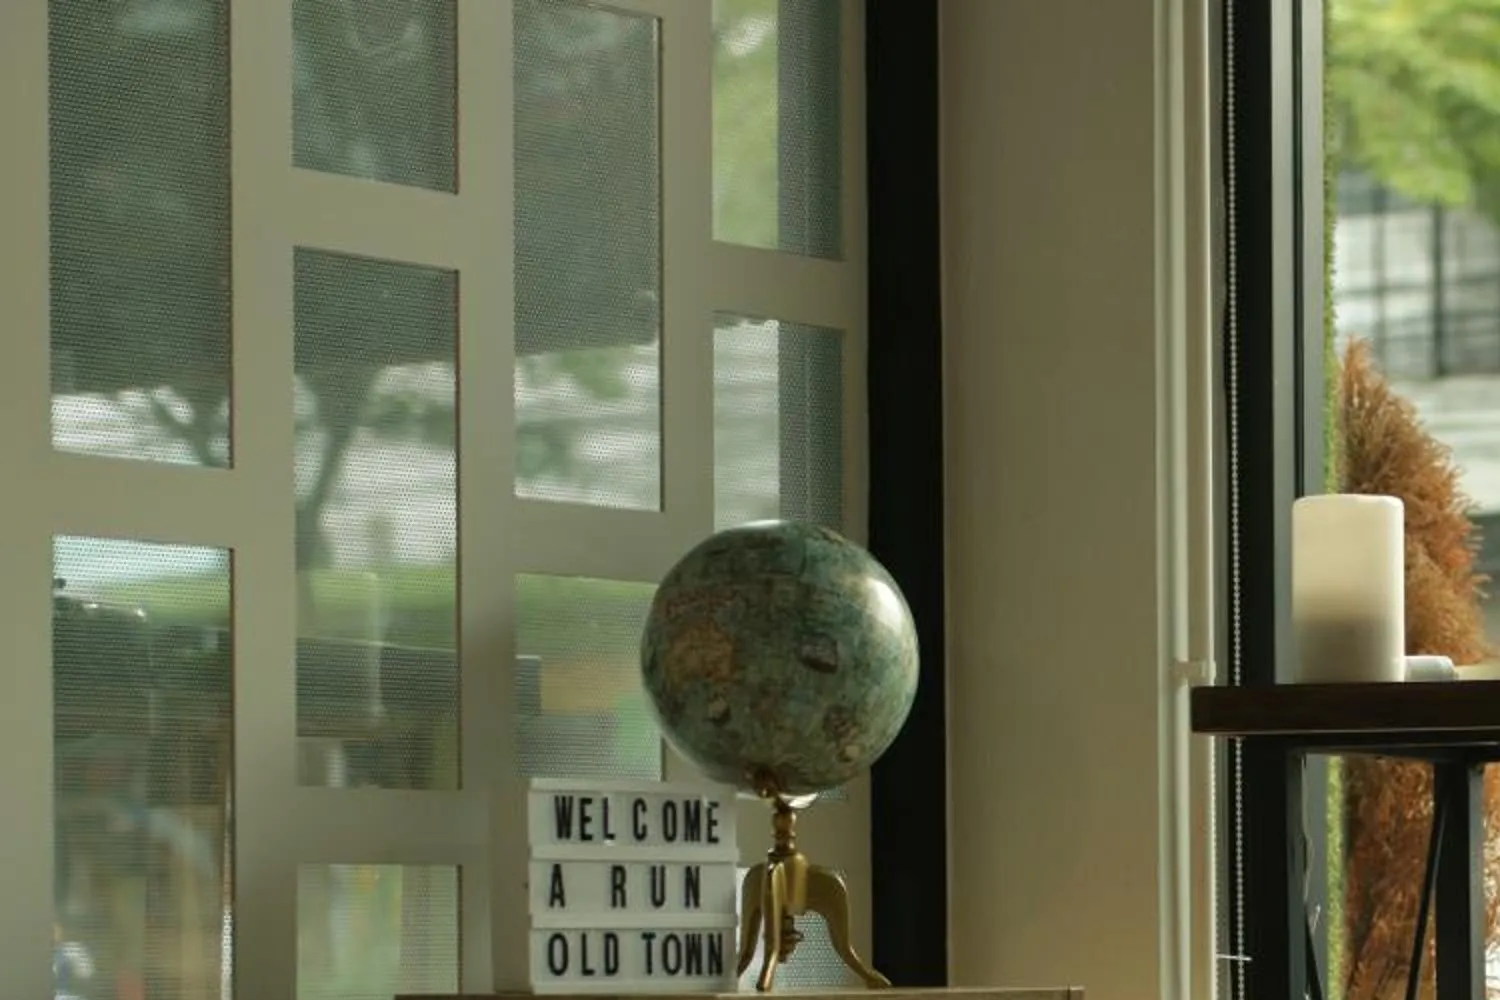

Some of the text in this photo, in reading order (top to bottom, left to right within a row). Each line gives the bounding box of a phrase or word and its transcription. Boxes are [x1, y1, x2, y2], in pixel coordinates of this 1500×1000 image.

[554, 796, 720, 843] WELCOME
[548, 863, 701, 909] A RUN
[548, 932, 724, 977] OLD TOWN
